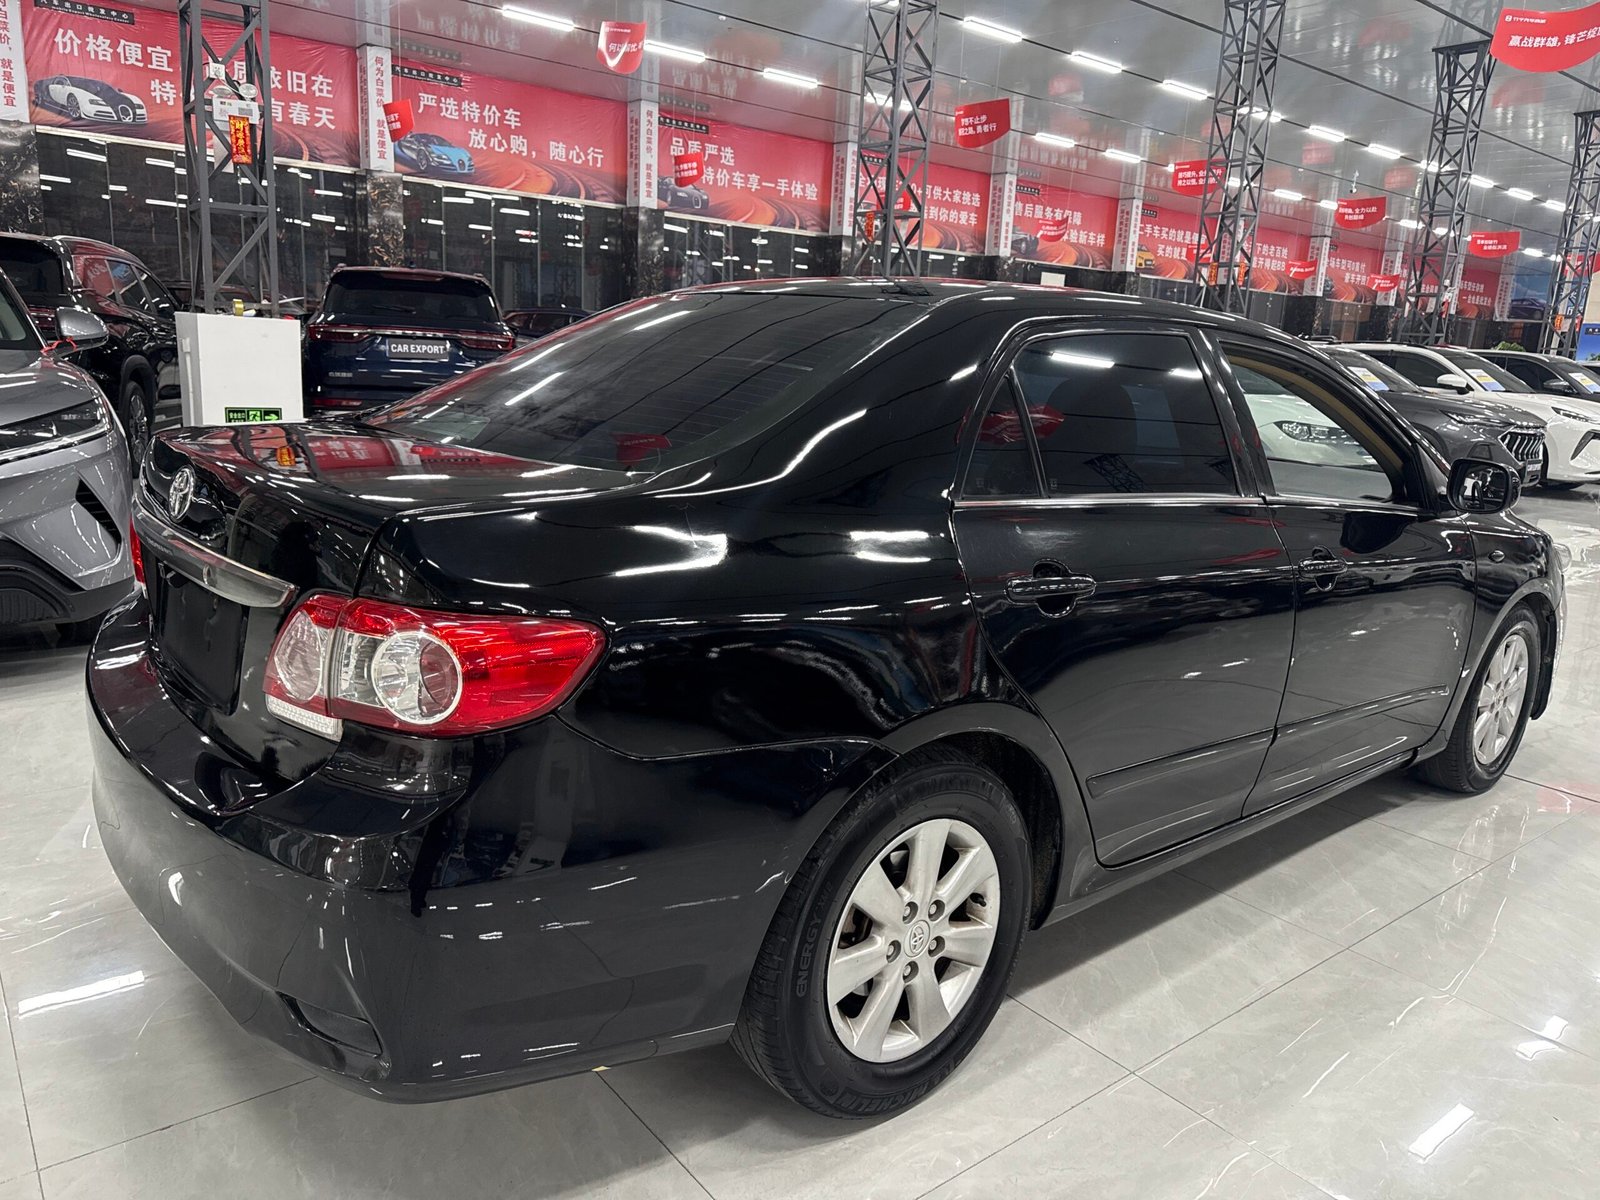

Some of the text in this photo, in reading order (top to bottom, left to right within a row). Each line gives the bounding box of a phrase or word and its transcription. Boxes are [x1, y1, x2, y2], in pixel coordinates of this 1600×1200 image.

[55, 28, 334, 99] 价格便宜 质依旧在
[418, 92, 521, 129] 严选特价车
[468, 129, 605, 168] 放心购，随心行
[670, 137, 736, 166] 品质严选
[1014, 201, 1082, 226] 售后服务有保障
[391, 344, 444, 354] CAR EXPORT
